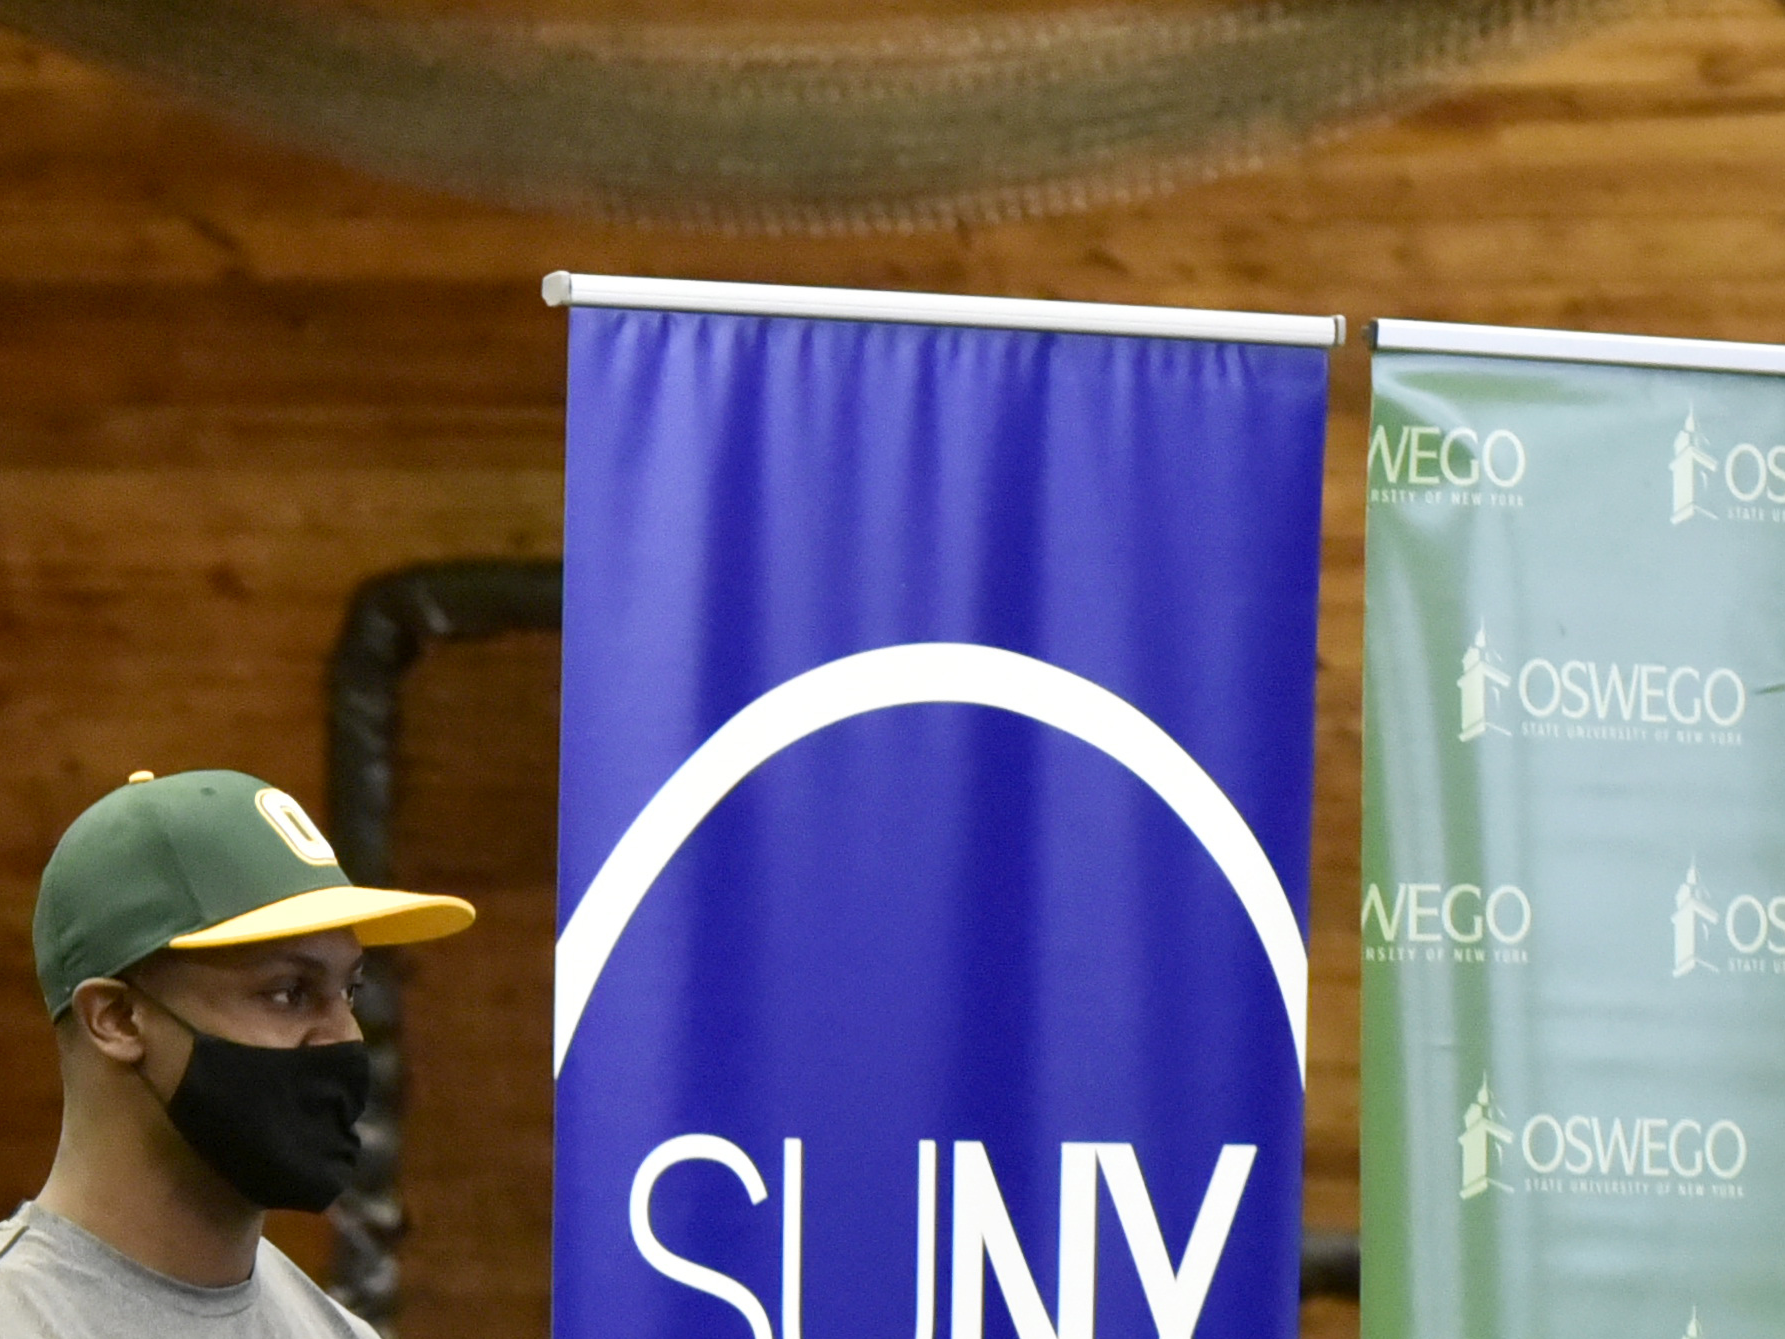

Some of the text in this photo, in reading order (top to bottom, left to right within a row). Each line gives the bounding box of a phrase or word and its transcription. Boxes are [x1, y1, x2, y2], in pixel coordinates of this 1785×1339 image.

[1425, 491, 1442, 504] OF
[1452, 491, 1480, 505] NEW
[1490, 493, 1524, 506] YORK
[1519, 658, 1745, 726] OSWEGO
[1426, 948, 1443, 962] OF
[1453, 948, 1485, 963] NEW
[1494, 949, 1528, 964] YORK
[1521, 1113, 1747, 1179] OSWEGO
[1524, 1178, 1744, 1197] STATE UNIVERSITY OF NEW YORK
